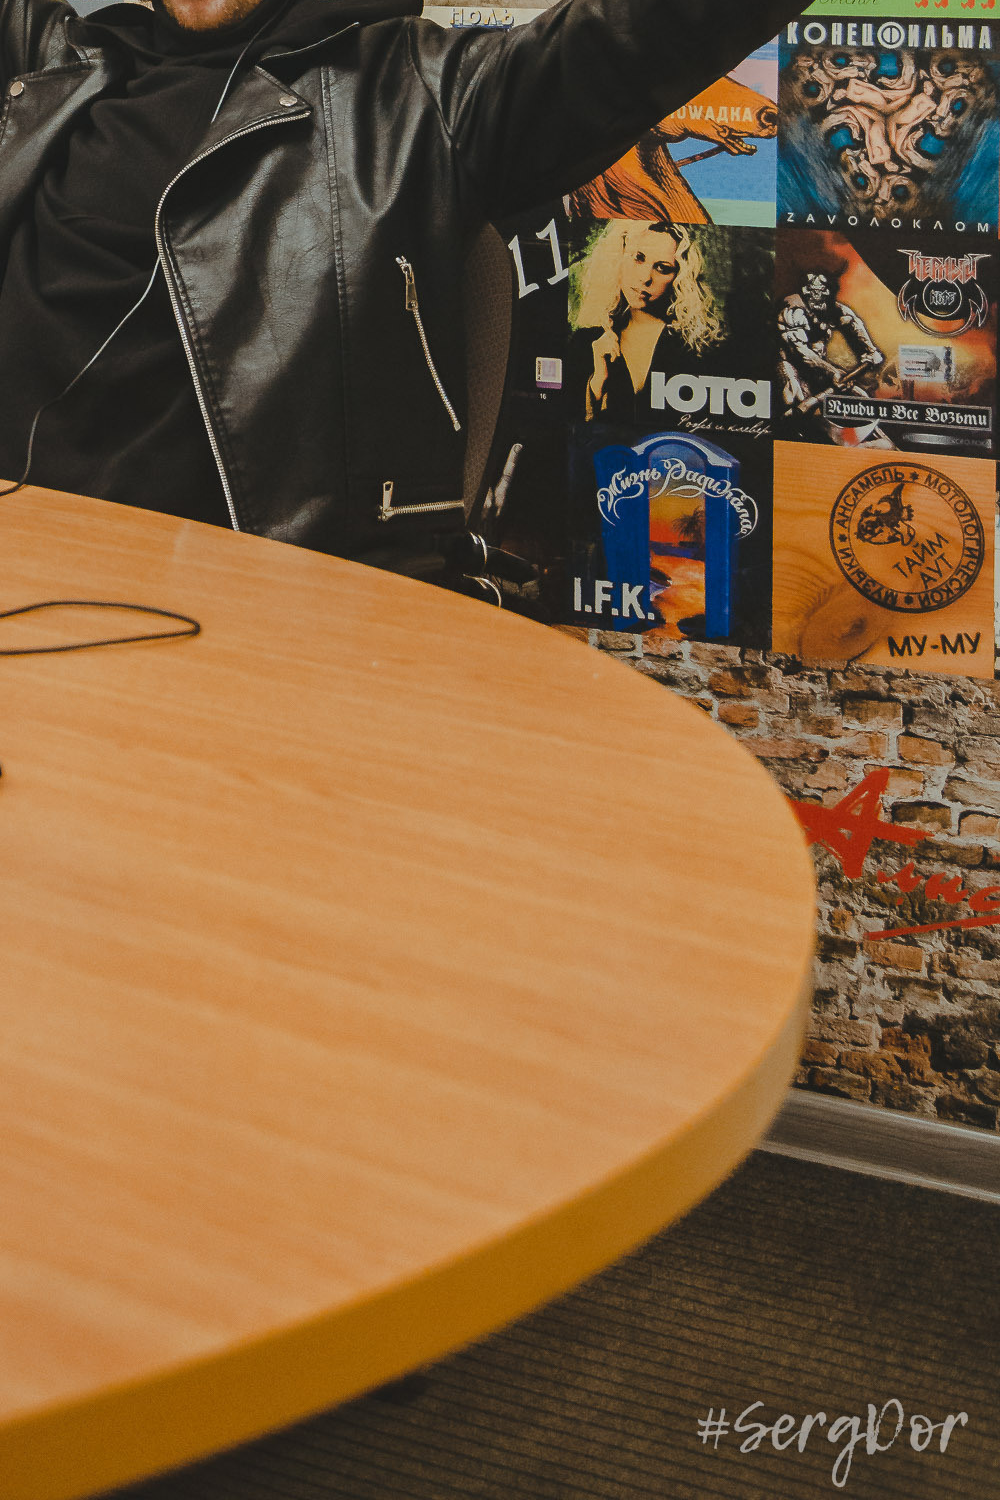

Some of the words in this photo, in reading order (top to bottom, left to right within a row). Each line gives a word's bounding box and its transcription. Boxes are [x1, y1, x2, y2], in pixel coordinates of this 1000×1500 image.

[836, 467, 905, 530] АНСАМБЛЬ
[837, 546, 899, 606] МУЗЫКИ
[892, 531, 950, 579] ТАЙМ
[919, 552, 954, 591] АУТ
[573, 576, 656, 622] I.F.K.
[887, 631, 982, 658] МУ-МУ
